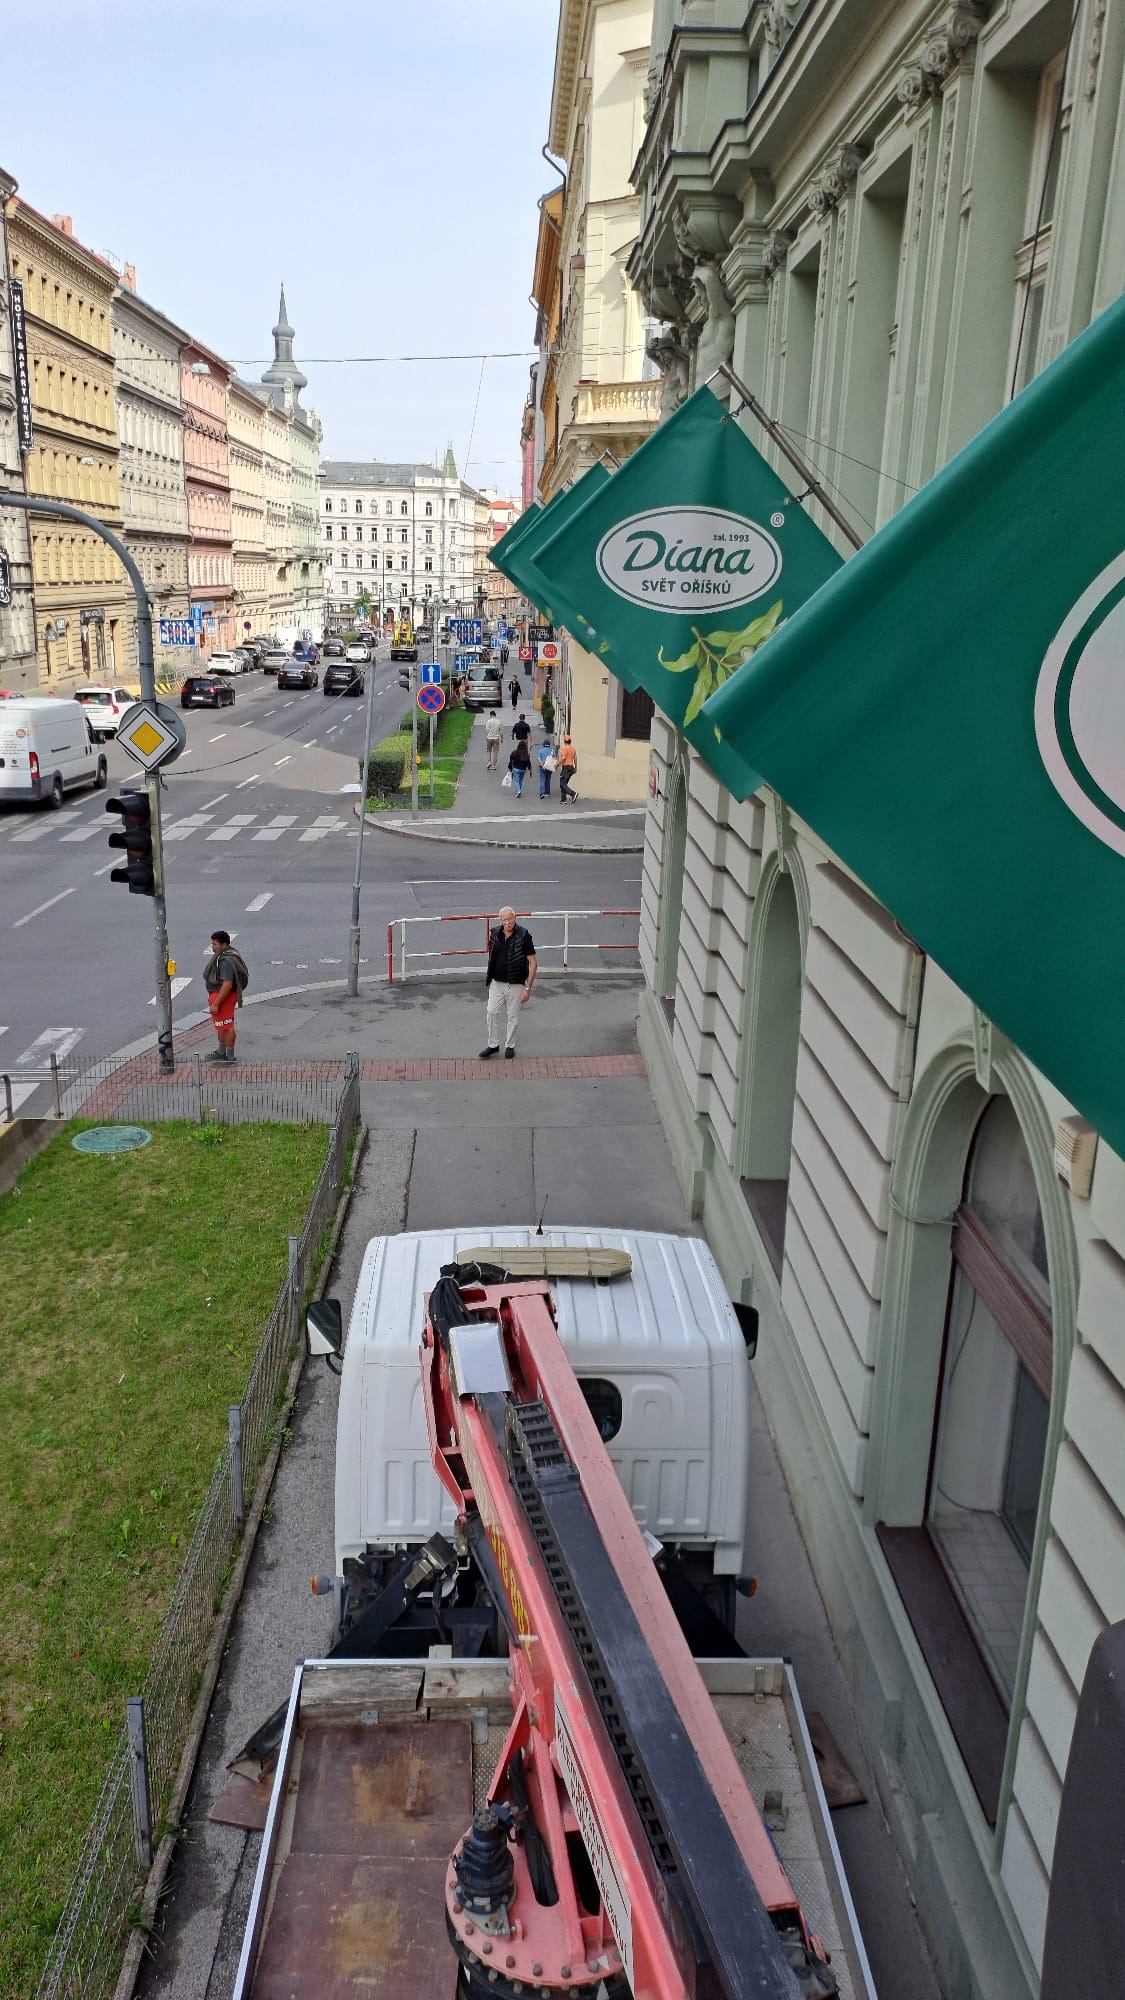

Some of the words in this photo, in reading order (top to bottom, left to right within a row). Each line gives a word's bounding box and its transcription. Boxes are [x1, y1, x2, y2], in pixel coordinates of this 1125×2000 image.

[14, 295, 23, 339] HOTEL
[18, 353, 30, 439] APARTMENTS
[623, 530, 755, 575] Diana
[729, 534, 750, 542] 1993
[641, 578, 676, 593] SVĚT
[680, 579, 731, 595] OŘÍŠKŮ
